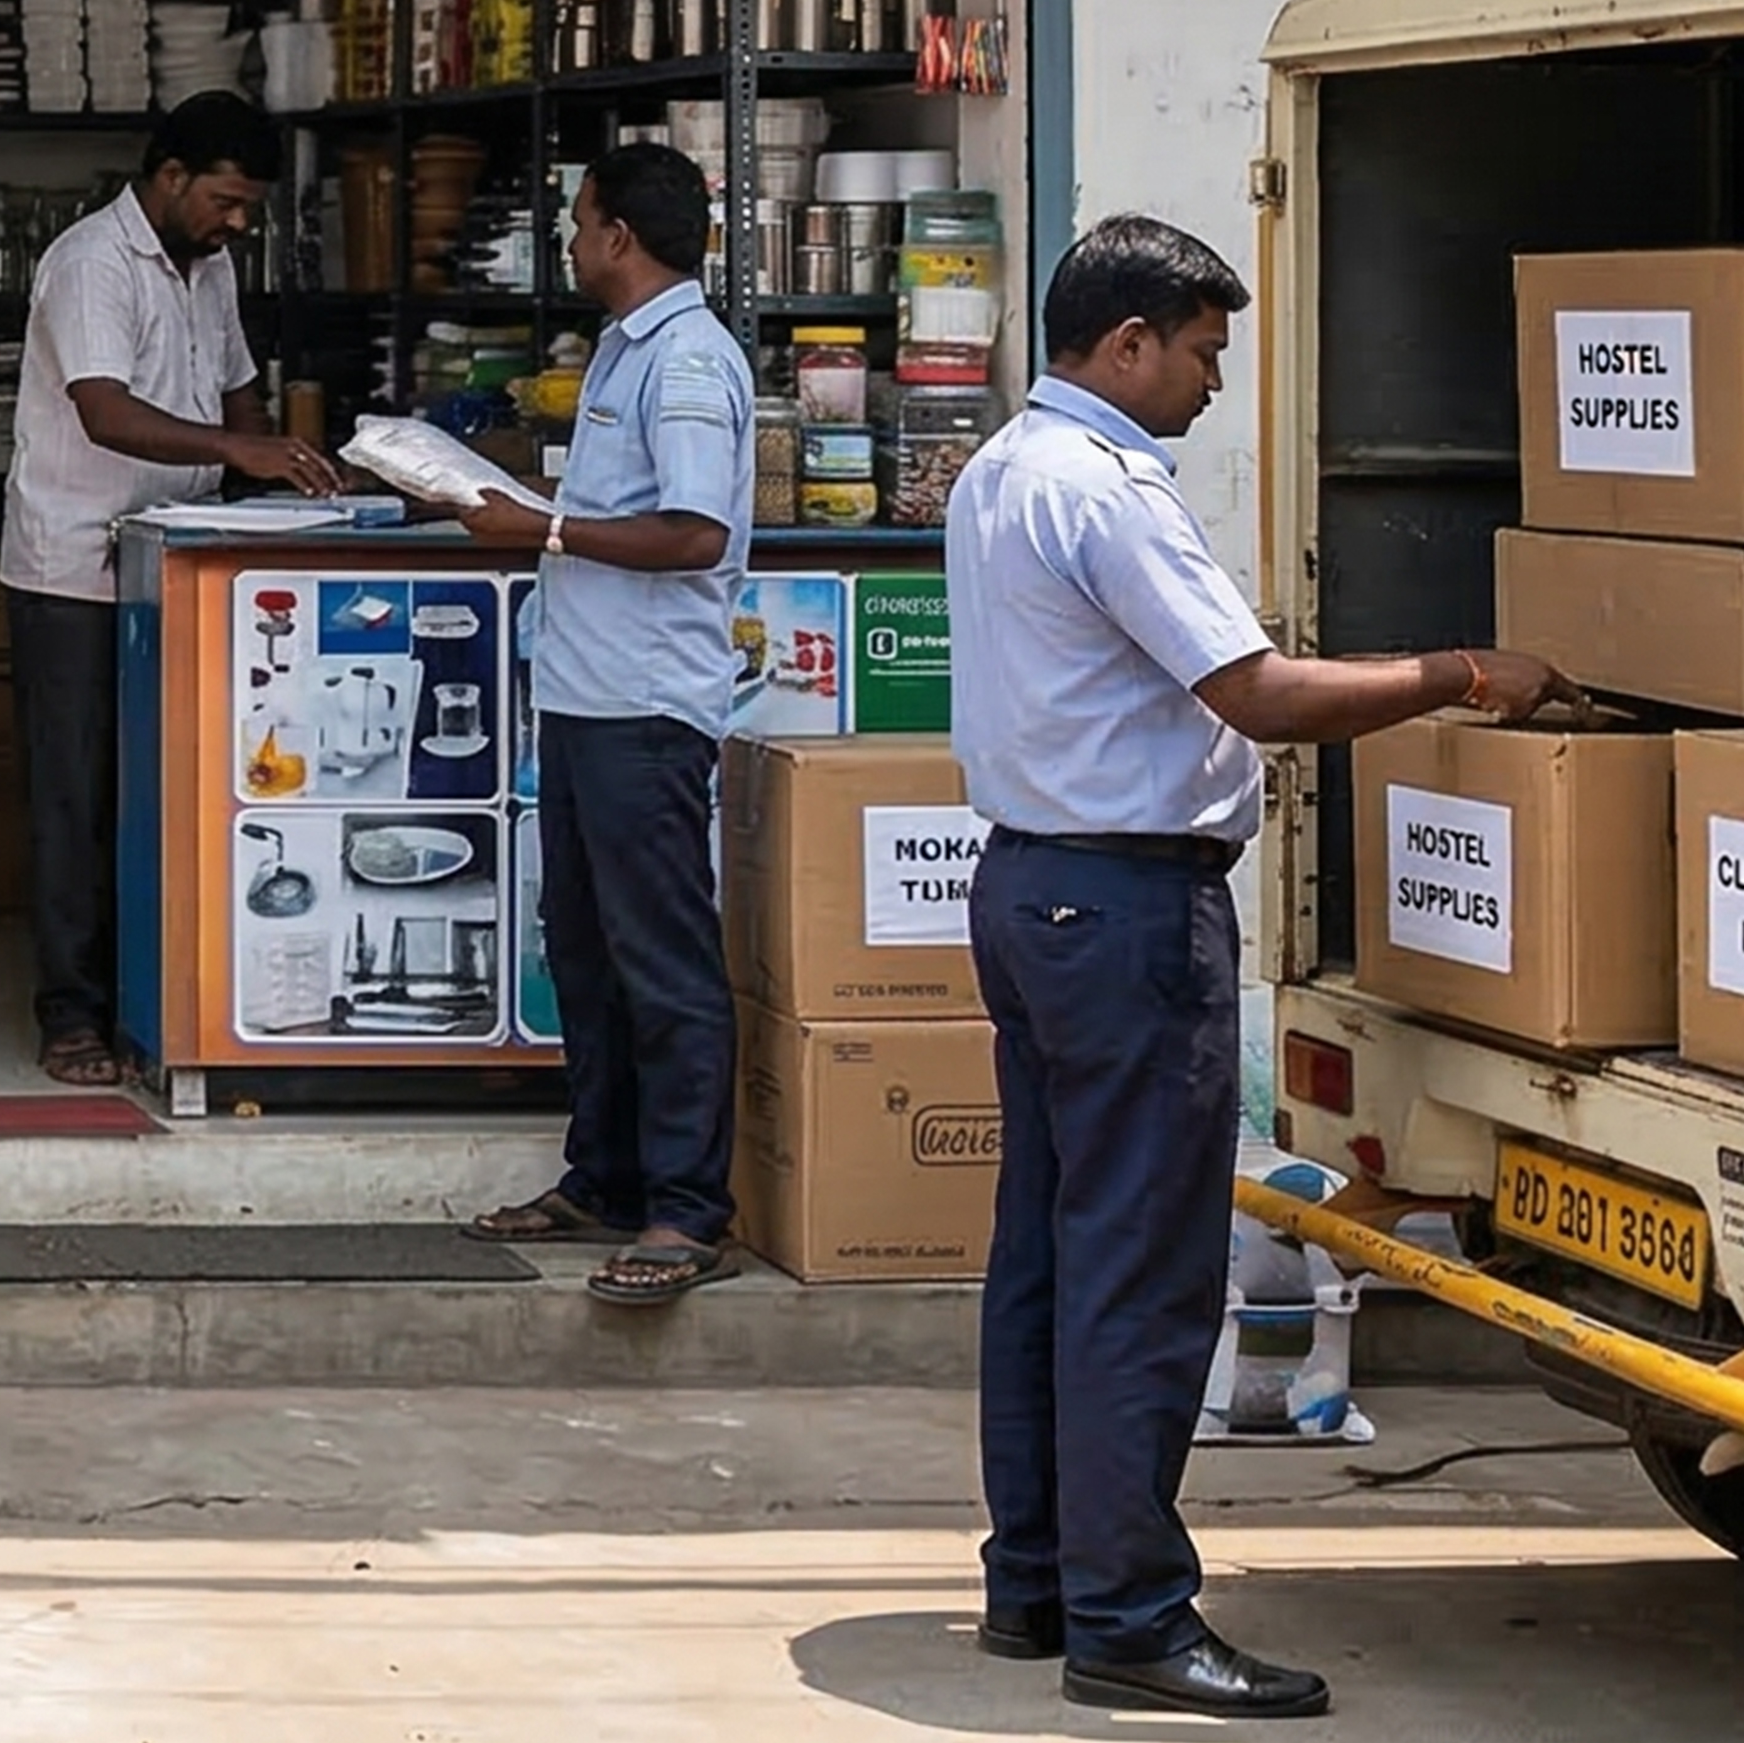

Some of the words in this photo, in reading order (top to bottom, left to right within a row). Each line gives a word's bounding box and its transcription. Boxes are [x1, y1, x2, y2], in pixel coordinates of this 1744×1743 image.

[1579, 343, 1667, 375] HOSTEL
[1570, 397, 1679, 430] SUPPLIES
[1406, 821, 1491, 869] HOSTEL
